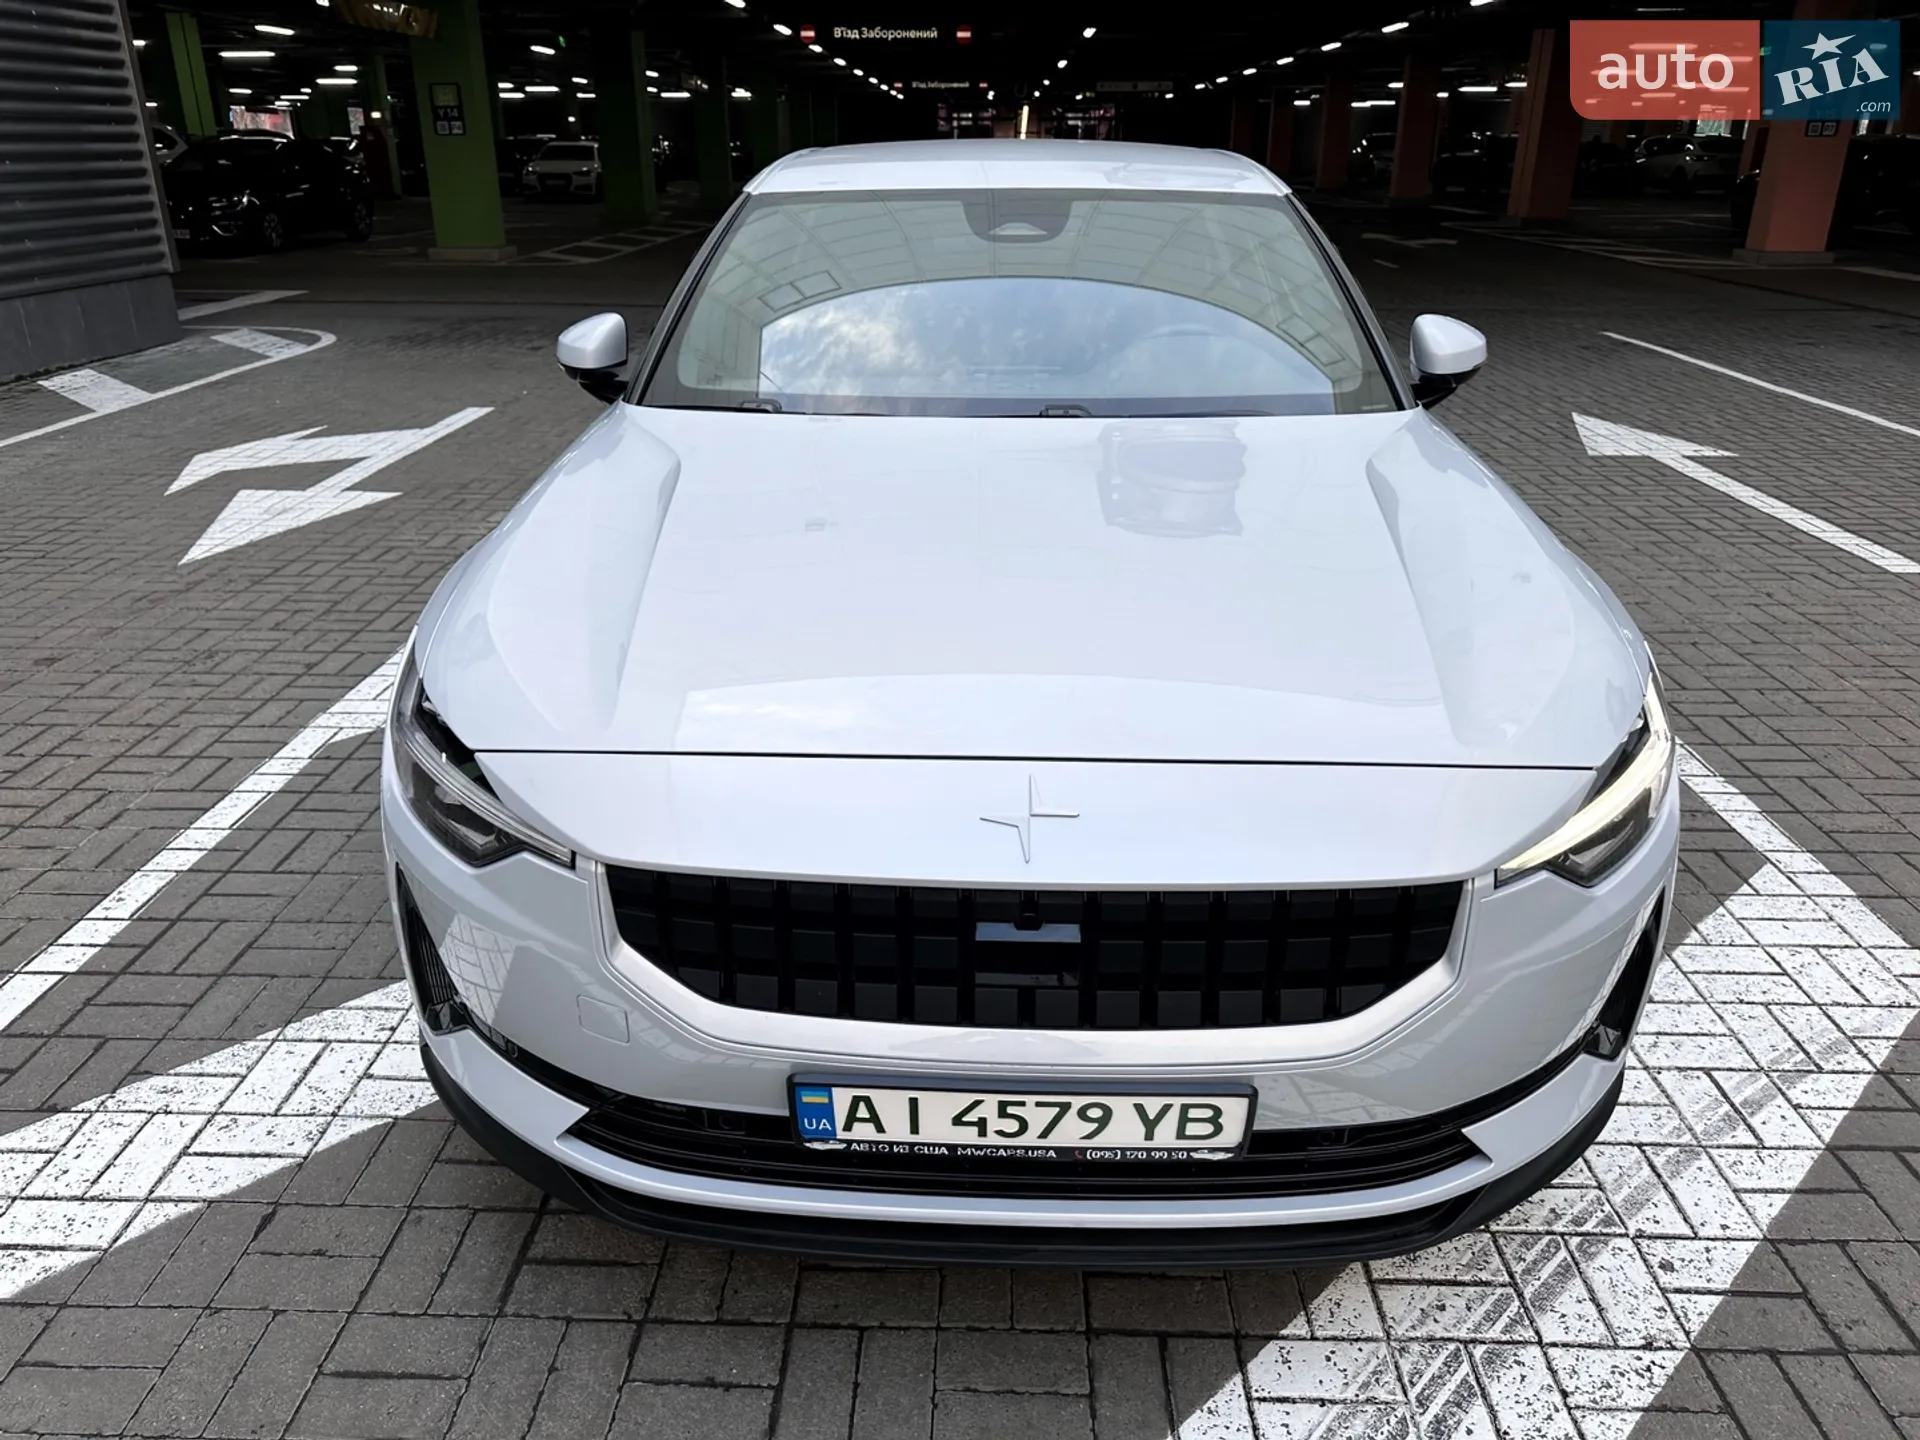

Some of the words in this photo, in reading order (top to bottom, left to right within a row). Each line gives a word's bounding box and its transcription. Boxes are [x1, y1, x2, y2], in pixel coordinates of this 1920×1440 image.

[833, 27, 860, 40] В'їзд
[860, 26, 938, 41] Заборонений
[803, 1117, 833, 1131] UA
[950, 1098, 1114, 1140] 4579
[1132, 1102, 1225, 1142] YB
[850, 1142, 890, 1152] АВТО
[892, 1144, 910, 1154] ИЗ
[913, 1145, 949, 1156] США
[1150, 1150, 1168, 1160] 99
[1171, 1150, 1187, 1160] 50
